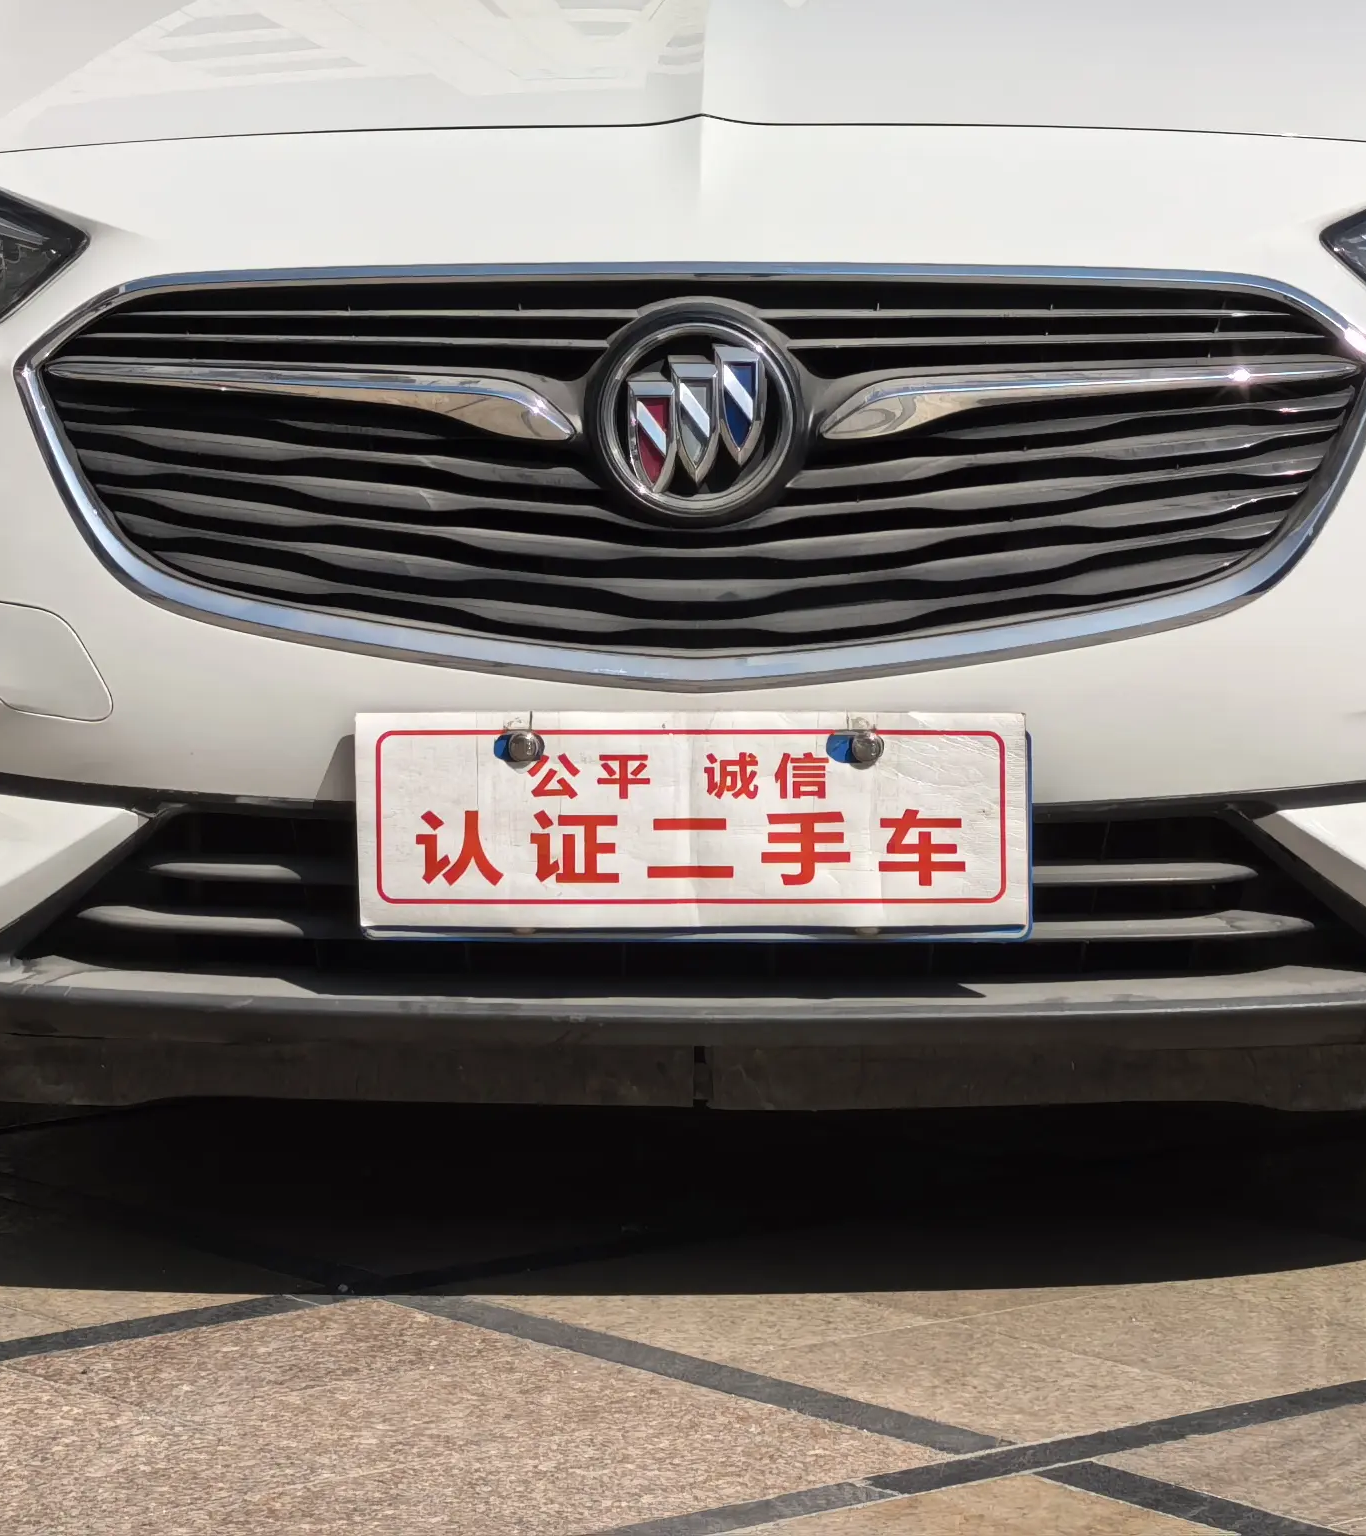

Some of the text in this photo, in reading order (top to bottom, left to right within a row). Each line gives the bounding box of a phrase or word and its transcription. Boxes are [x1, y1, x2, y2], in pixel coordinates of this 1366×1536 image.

[527, 751, 830, 800] 公平 诚信
[415, 809, 967, 887] 认证二手车
